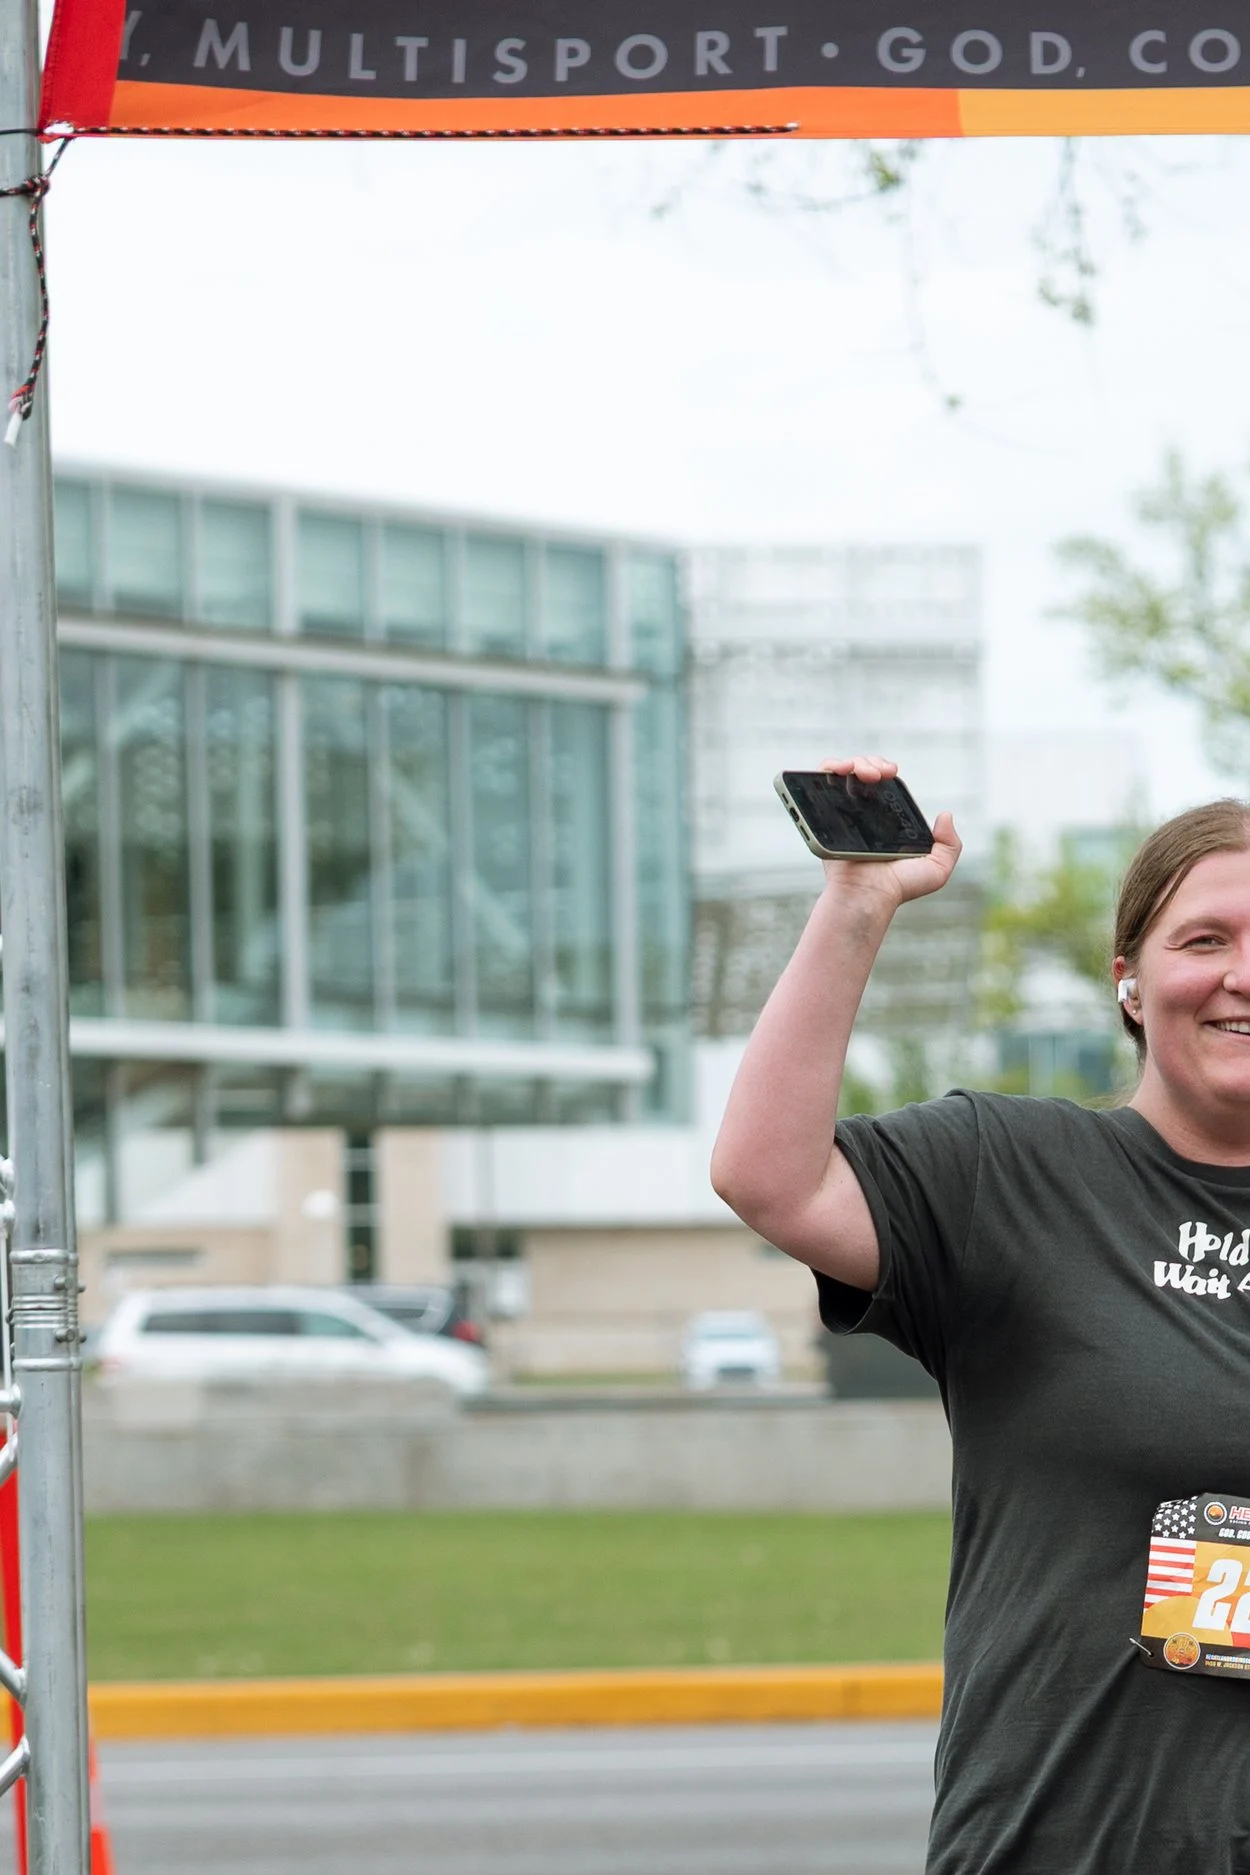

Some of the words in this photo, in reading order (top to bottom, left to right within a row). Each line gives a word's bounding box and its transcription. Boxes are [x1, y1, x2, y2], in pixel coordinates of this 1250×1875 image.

[193, 18, 789, 85] MULTISPORT
[875, 26, 1088, 79] GOD,
[1178, 1221, 1250, 1266] Hold
[1153, 1260, 1232, 1300] Wait
